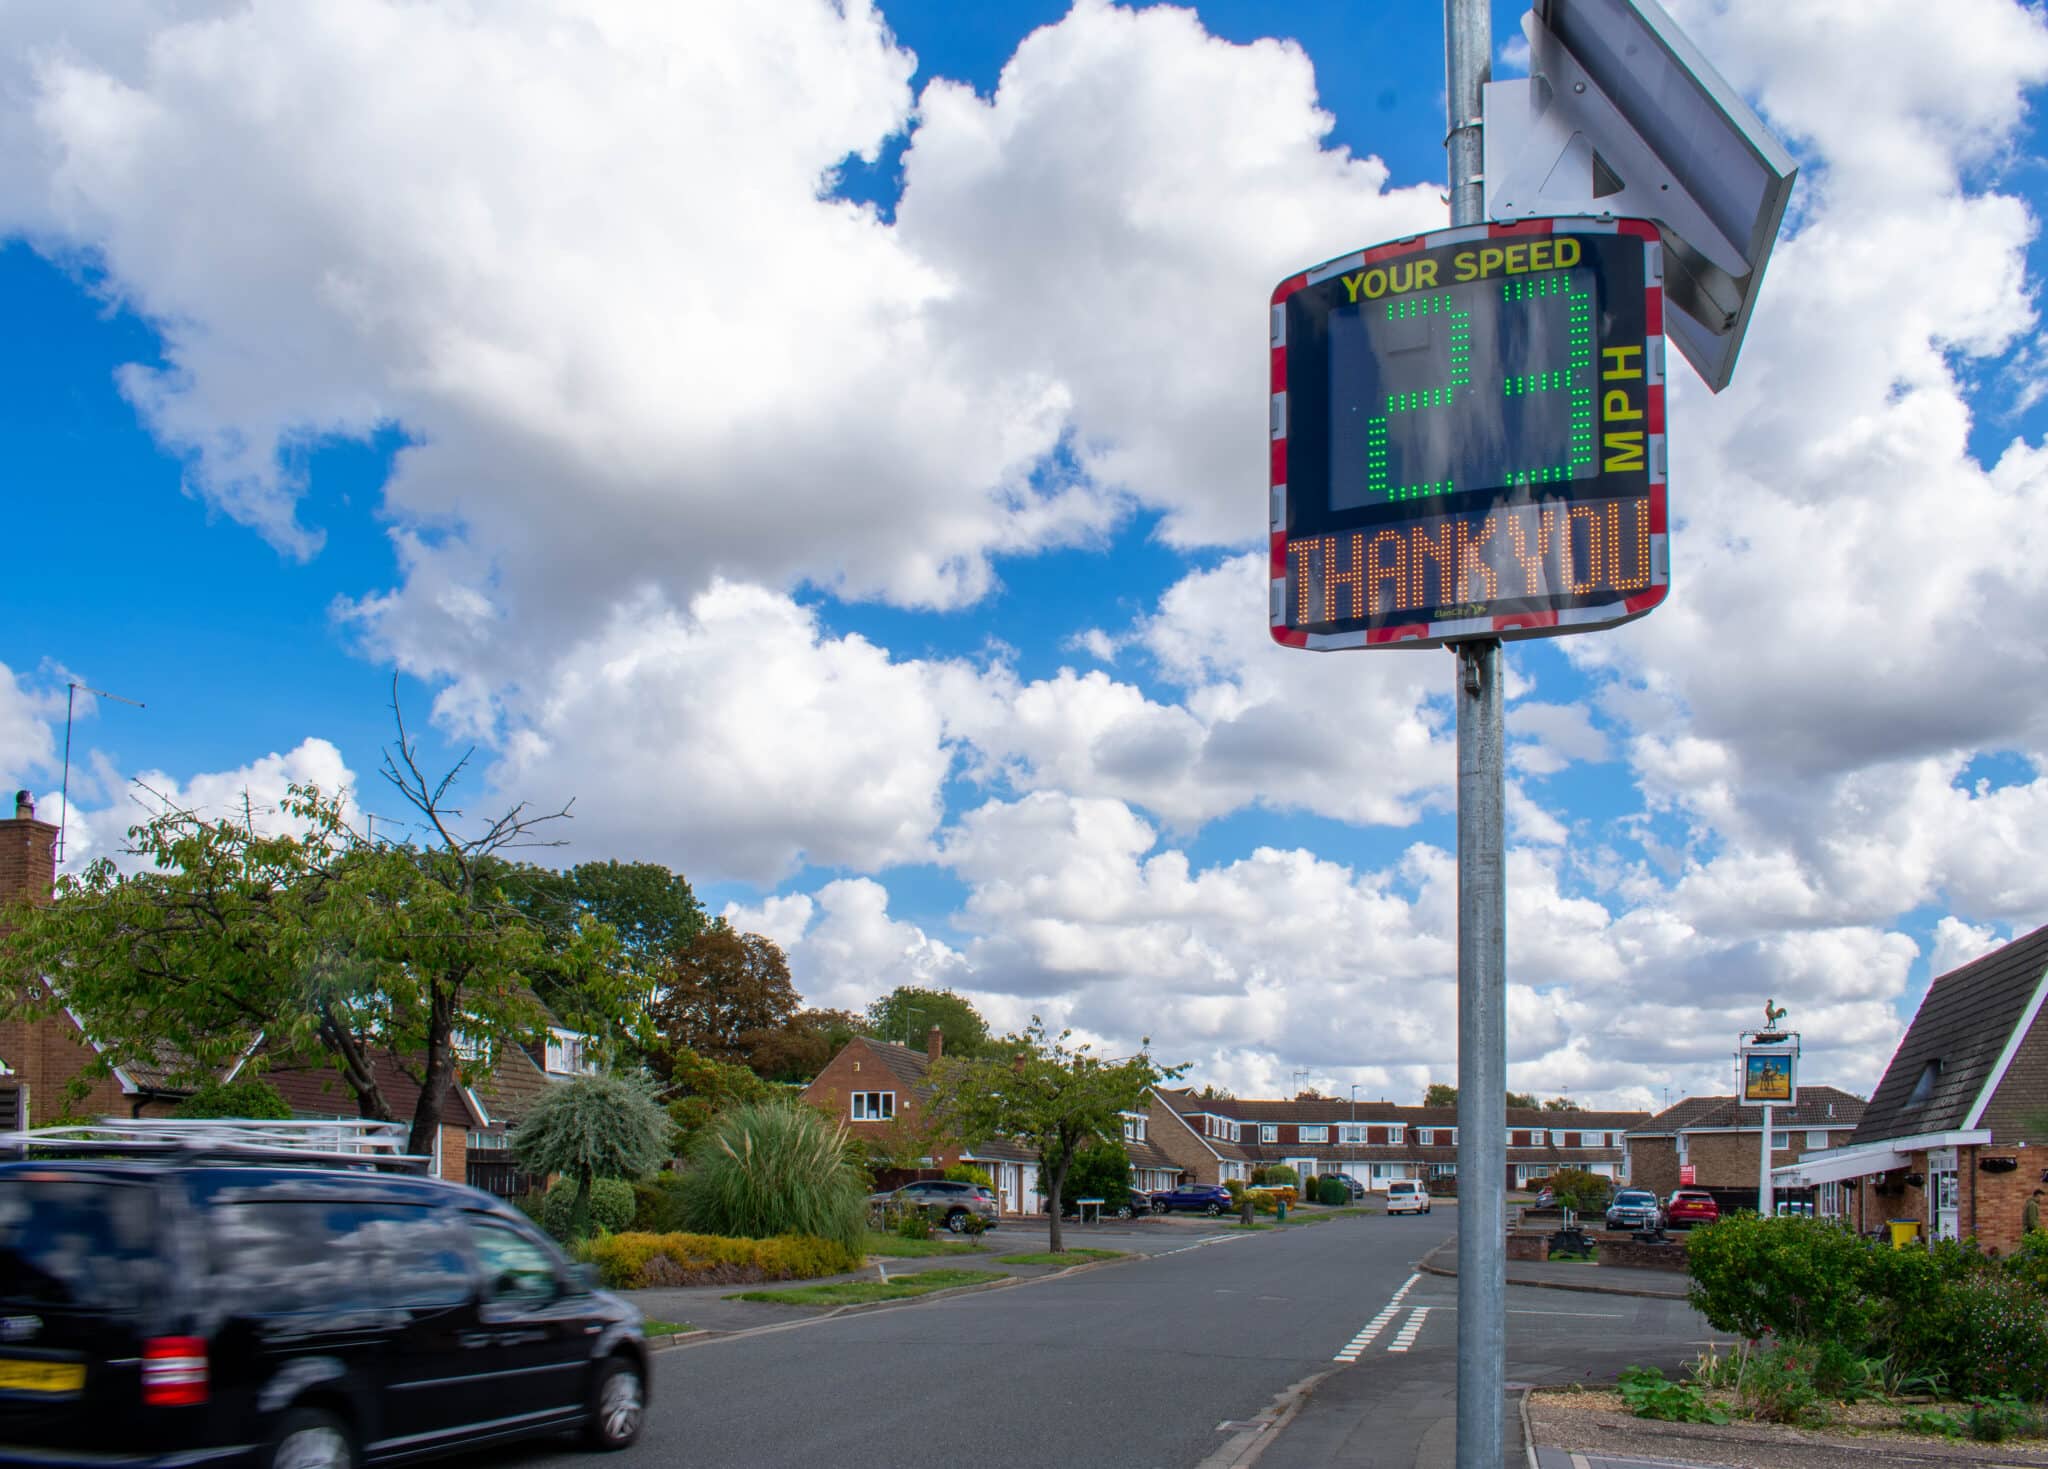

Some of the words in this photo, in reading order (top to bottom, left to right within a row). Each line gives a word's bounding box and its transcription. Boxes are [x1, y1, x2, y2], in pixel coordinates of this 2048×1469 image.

[1341, 258, 1439, 303] YOUR
[1454, 238, 1581, 281] SPEED
[1368, 274, 1592, 502] 23
[1602, 344, 1645, 473] MPH
[1288, 516, 1498, 625] THANK
[1508, 498, 1650, 596] YOU
